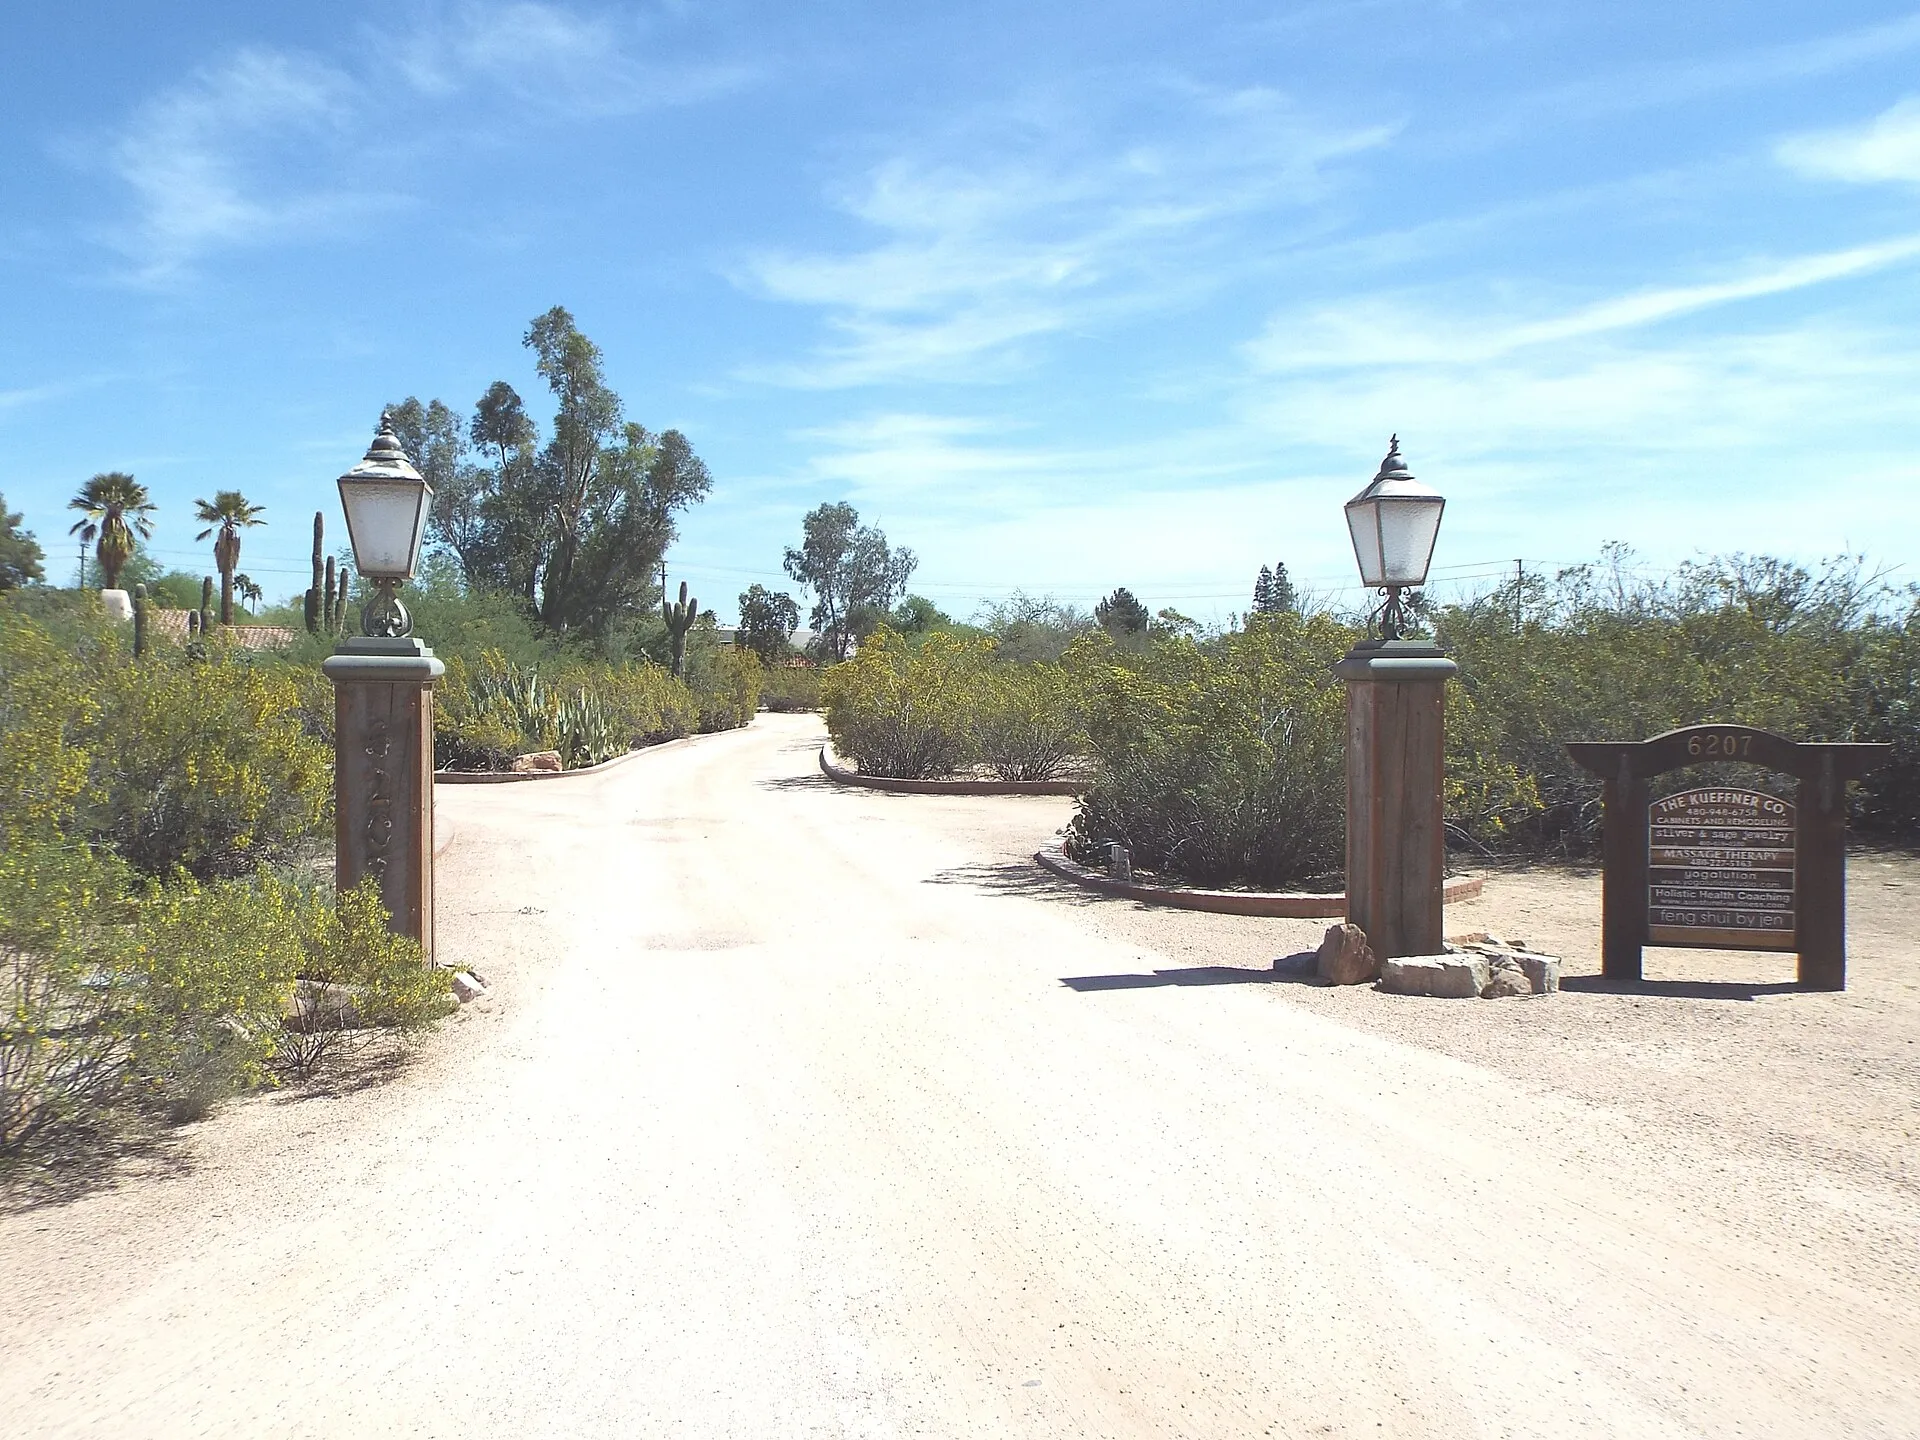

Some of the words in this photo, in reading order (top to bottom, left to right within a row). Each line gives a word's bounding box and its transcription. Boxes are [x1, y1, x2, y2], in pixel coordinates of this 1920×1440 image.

[1687, 734, 1753, 756] 6207
[1659, 797, 1686, 813] THE
[1689, 792, 1760, 808] KUEFFNER
[1763, 800, 1786, 817] CO.
[1656, 817, 1701, 825] CABINETS
[1703, 818, 1725, 826] AND
[1727, 818, 1789, 827] REMODELING
[1656, 828, 1695, 838] silver
[1698, 830, 1708, 838] &
[1711, 831, 1738, 840] sage
[1742, 830, 1789, 842] jewelry
[1663, 850, 1722, 859] MASSAGE
[1725, 851, 1780, 861] THERAPY
[1655, 888, 1697, 899] Holistic
[1699, 890, 1734, 900] Health
[1737, 891, 1790, 903] Coaching
[1660, 909, 1696, 926] feng
[1701, 911, 1730, 924] shui
[1736, 913, 1755, 928] by
[1760, 913, 1784, 928] jen
